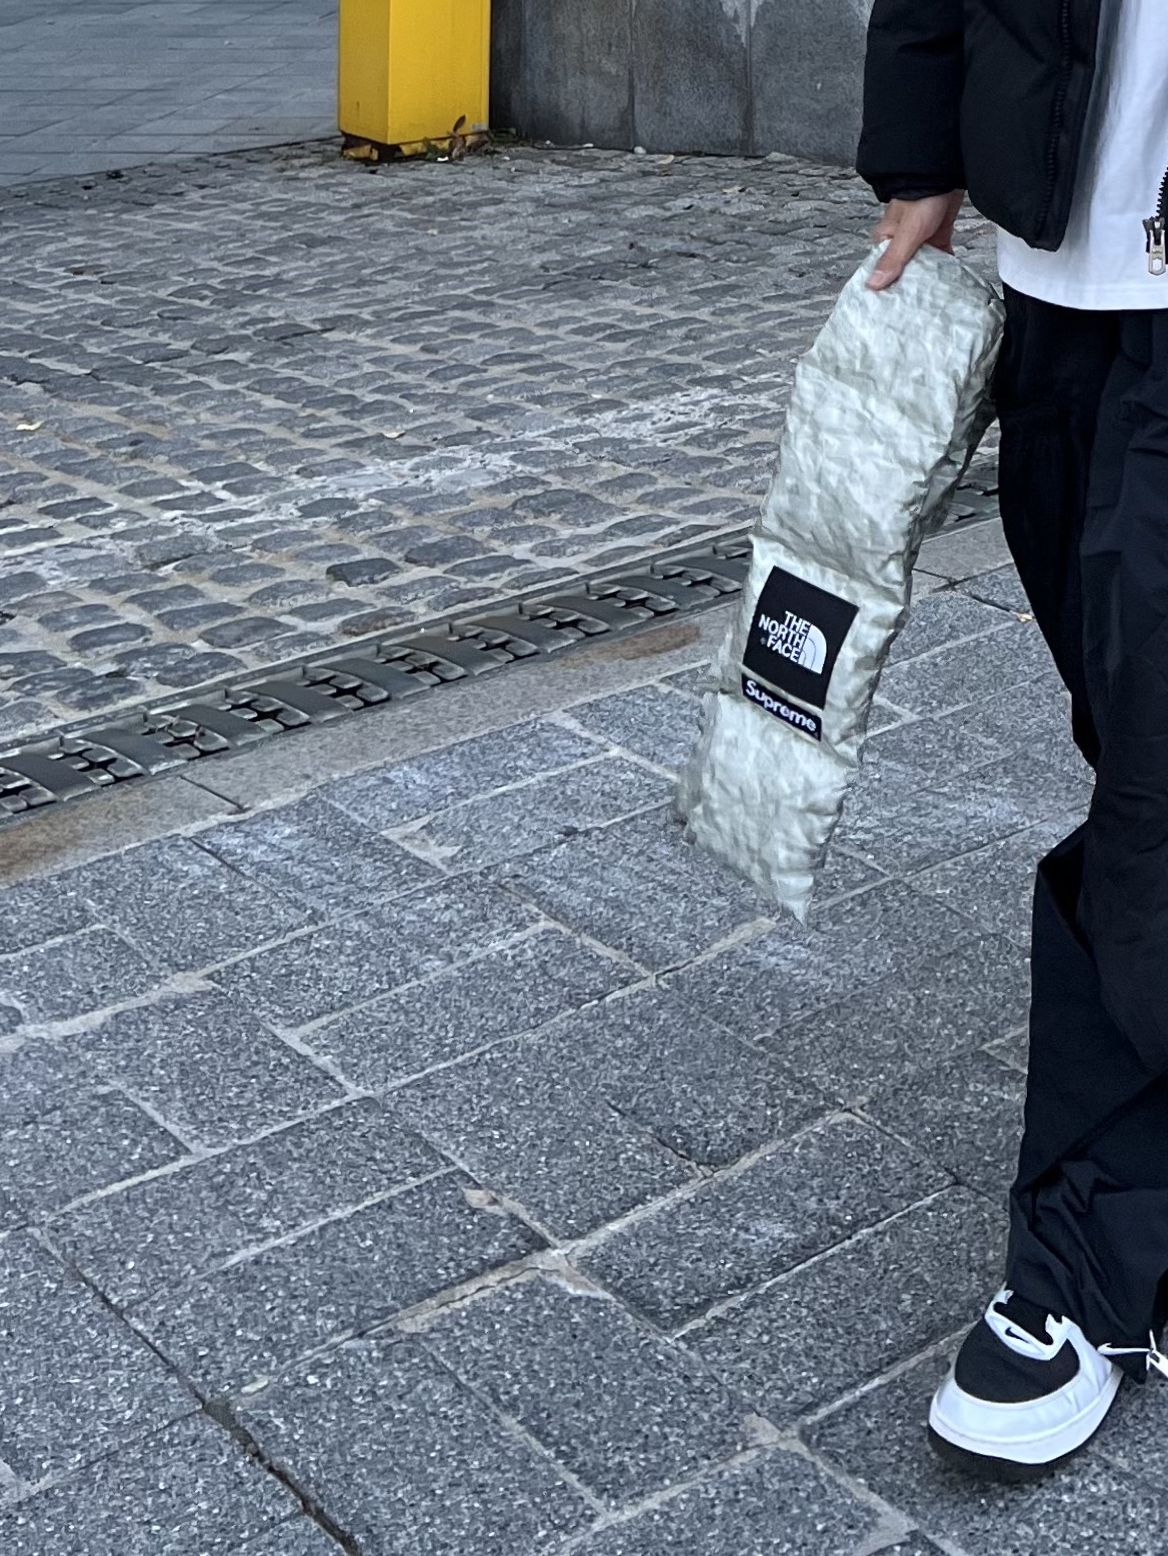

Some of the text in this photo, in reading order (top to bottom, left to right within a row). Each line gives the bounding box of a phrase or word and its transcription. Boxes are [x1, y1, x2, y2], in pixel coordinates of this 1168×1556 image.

[758, 613, 806, 649] NORTH
[785, 610, 811, 636] THE
[767, 634, 801, 664] FACE
[746, 679, 817, 732] Supreme
